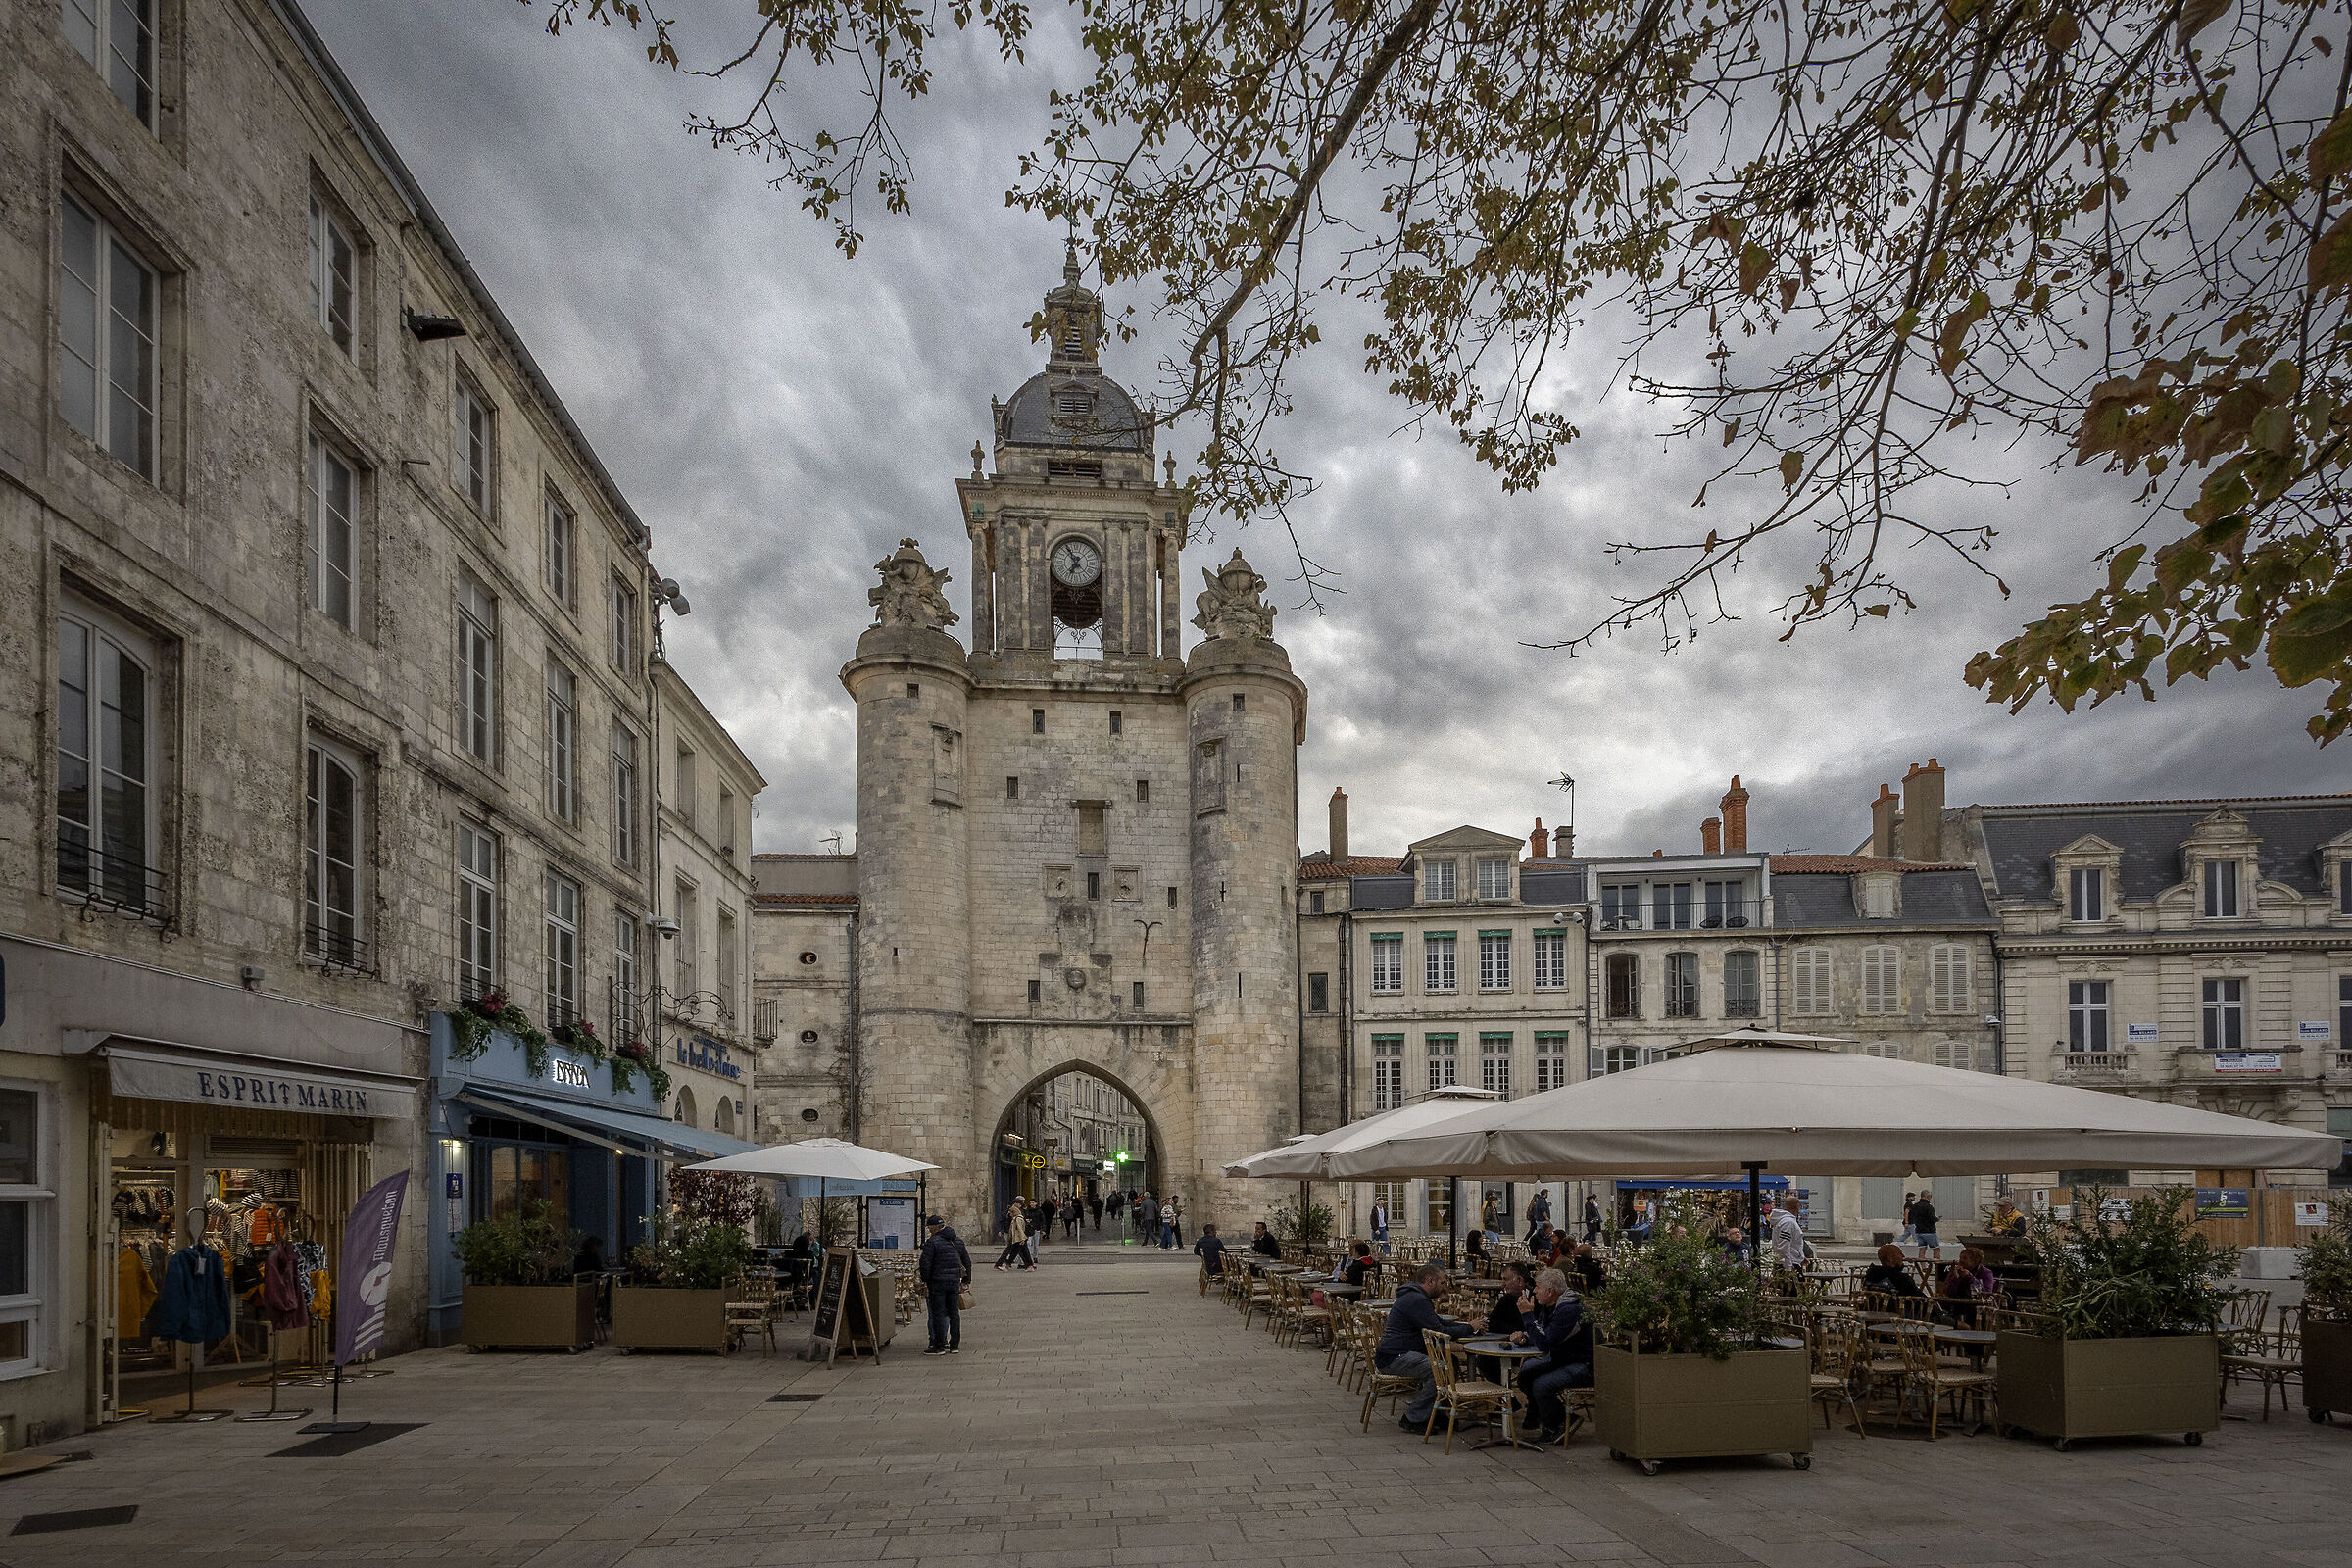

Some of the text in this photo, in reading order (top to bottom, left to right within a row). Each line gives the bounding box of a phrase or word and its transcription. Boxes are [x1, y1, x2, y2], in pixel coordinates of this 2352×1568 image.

[197, 1071, 368, 1111] ESPRIT MARIN
[372, 1189, 398, 1262] mousqueton
